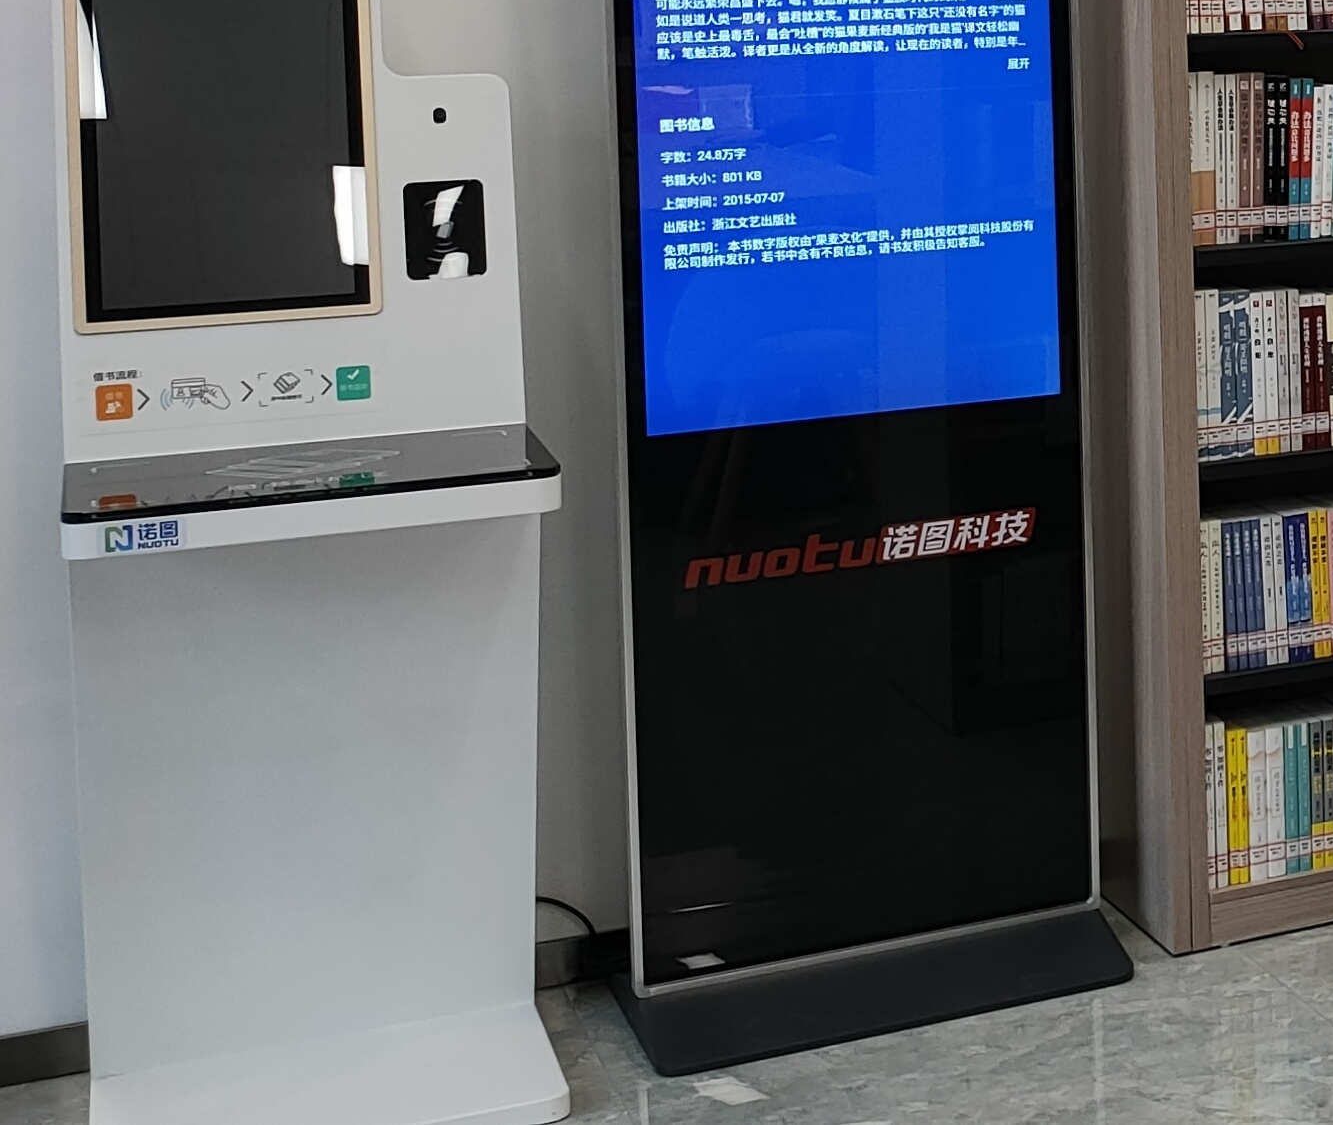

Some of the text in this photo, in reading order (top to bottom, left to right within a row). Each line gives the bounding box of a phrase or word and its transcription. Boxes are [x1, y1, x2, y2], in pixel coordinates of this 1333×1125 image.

[1007, 58, 1030, 70] 展开
[659, 117, 715, 134] 图书信息
[660, 148, 747, 165] 字数：24.8万字
[746, 170, 762, 182] KB
[662, 192, 785, 211] 上架时间：2015-07-07
[663, 213, 797, 234] 出版社：浙江文艺出版社
[137, 520, 178, 542] 诺图
[882, 510, 1032, 561] 诺图科技
[137, 537, 179, 550] NUOTU
